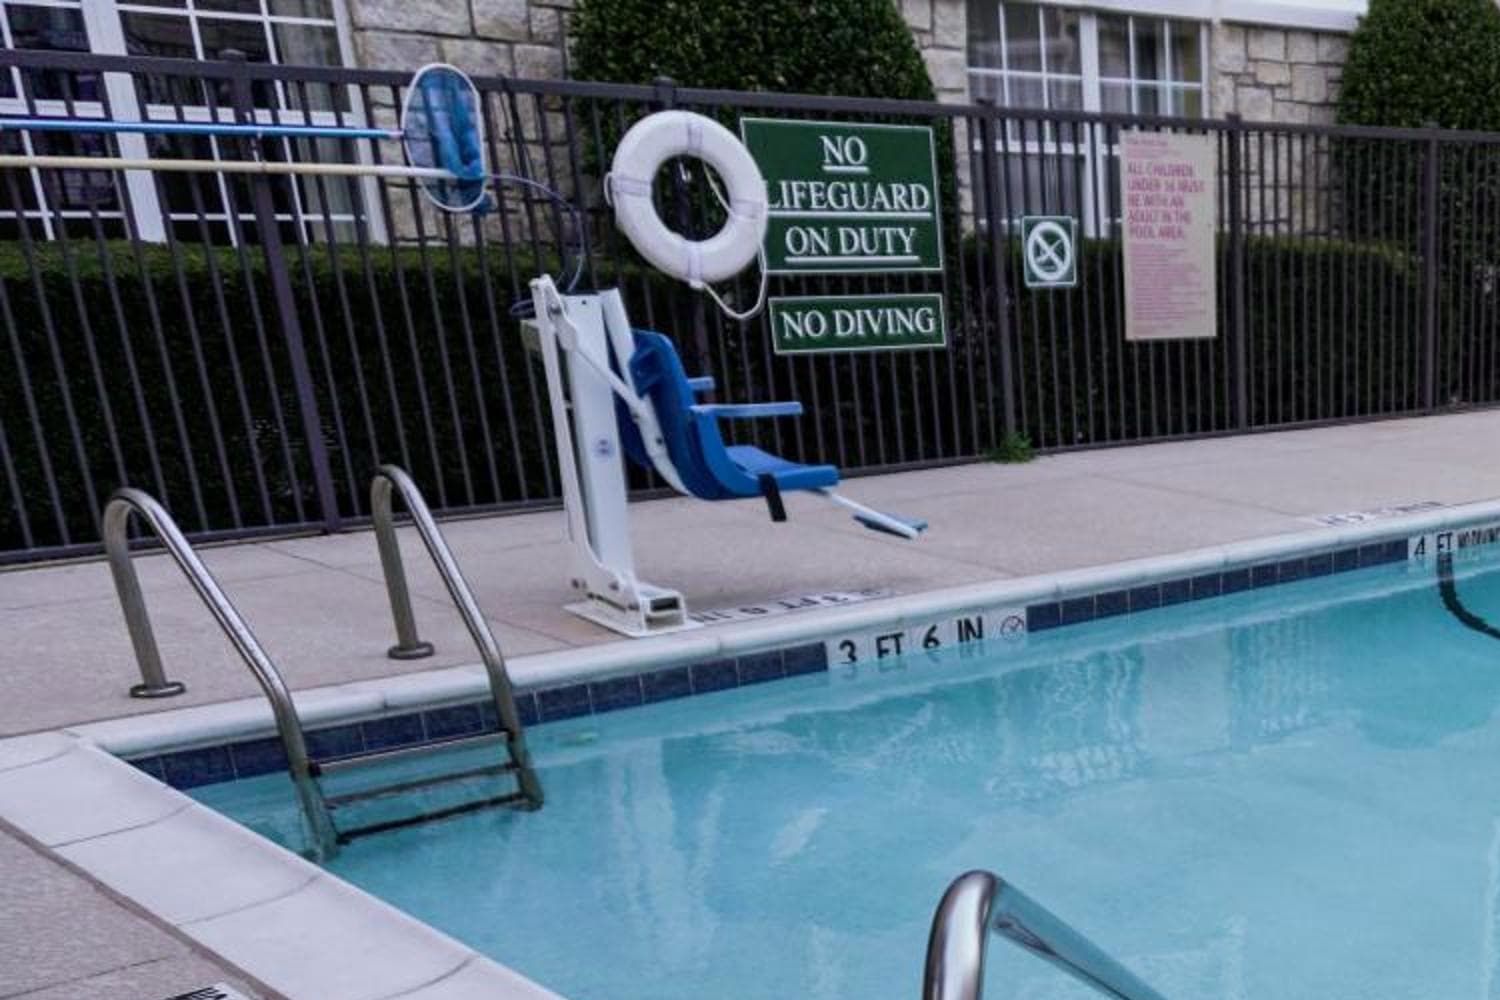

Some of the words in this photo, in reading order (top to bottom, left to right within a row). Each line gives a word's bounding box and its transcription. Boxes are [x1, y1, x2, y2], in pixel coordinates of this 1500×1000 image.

[820, 136, 867, 165] NO
[785, 226, 831, 255] ON
[838, 226, 917, 255] DUTY
[782, 311, 827, 338] NO
[834, 307, 936, 336] DIVING
[1413, 534, 1425, 556] 4
[1436, 531, 1452, 551] FT
[838, 638, 857, 665] 3
[875, 630, 905, 660] FT
[922, 624, 940, 649] 6
[956, 616, 984, 643] IN
